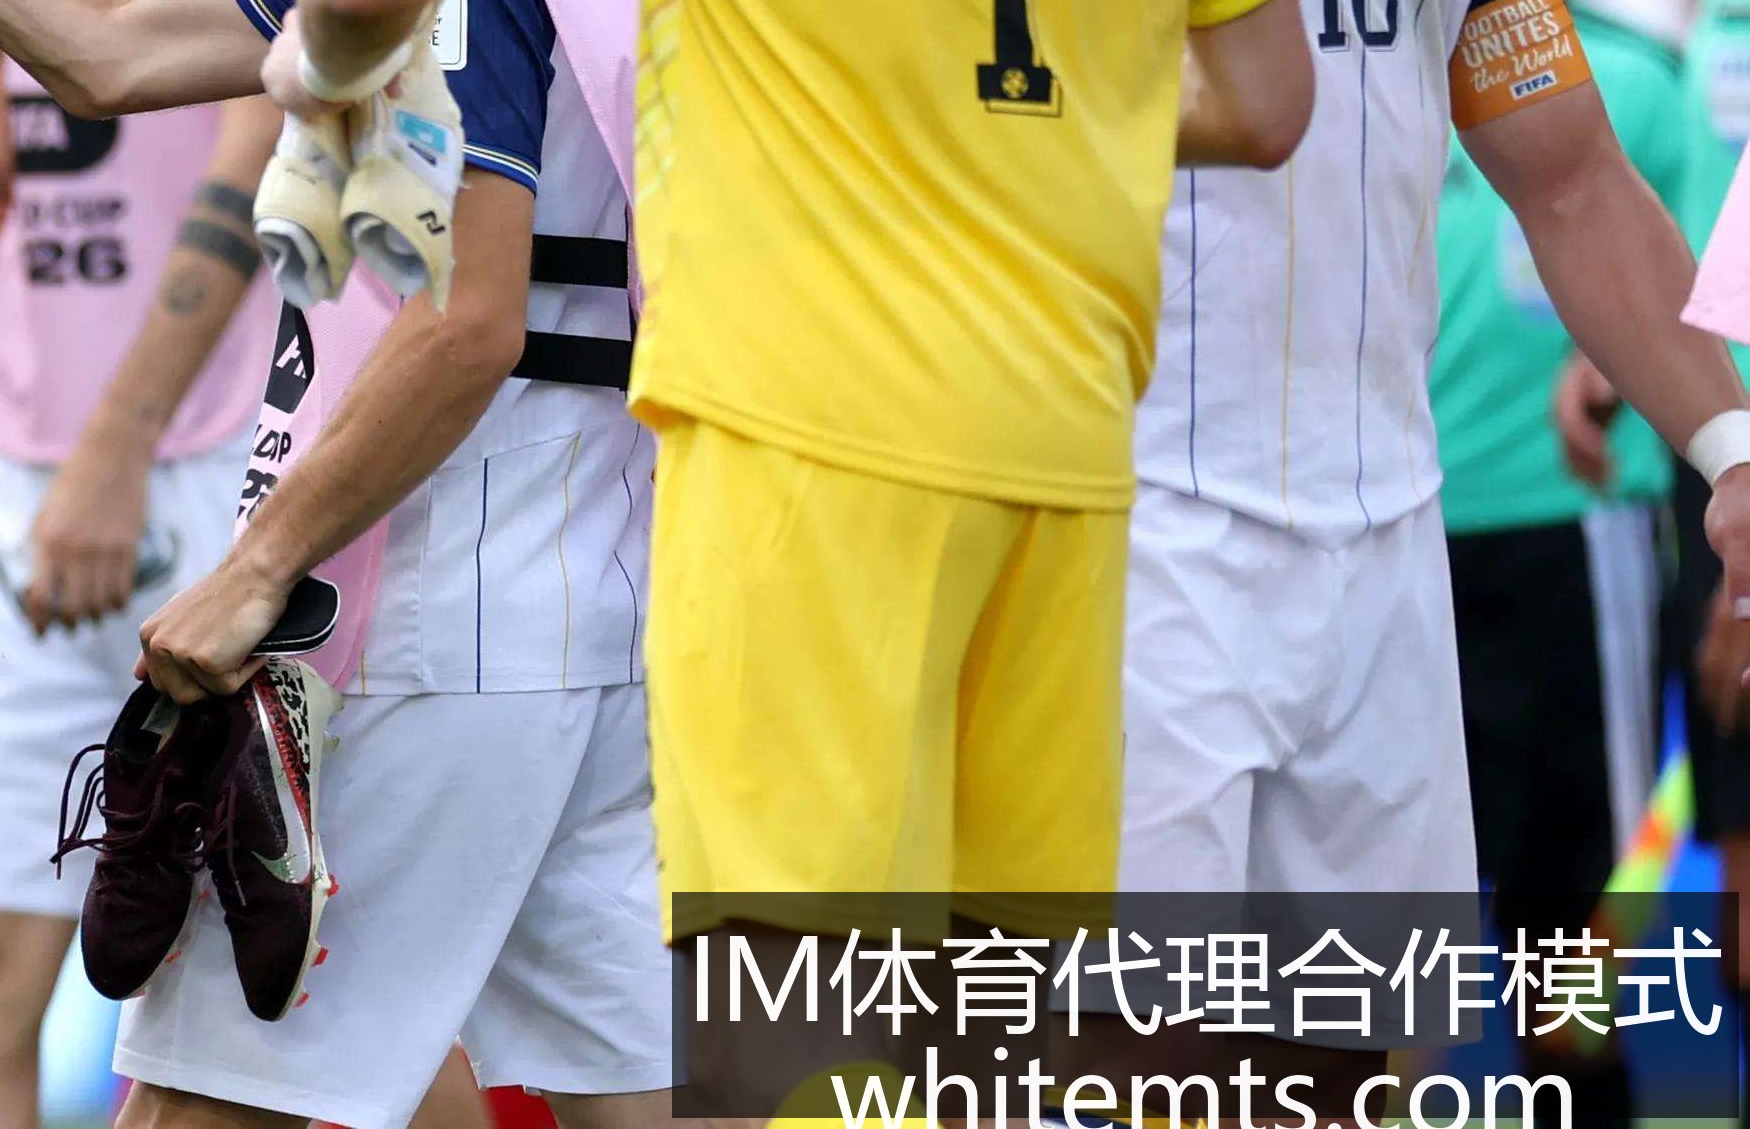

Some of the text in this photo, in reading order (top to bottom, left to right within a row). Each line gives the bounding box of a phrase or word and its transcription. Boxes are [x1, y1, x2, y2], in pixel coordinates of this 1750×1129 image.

[1460, 10, 1561, 69] UNITES
[1471, 33, 1574, 93] the World
[1513, 73, 1555, 98] FIFA
[24, 238, 127, 286] 26
